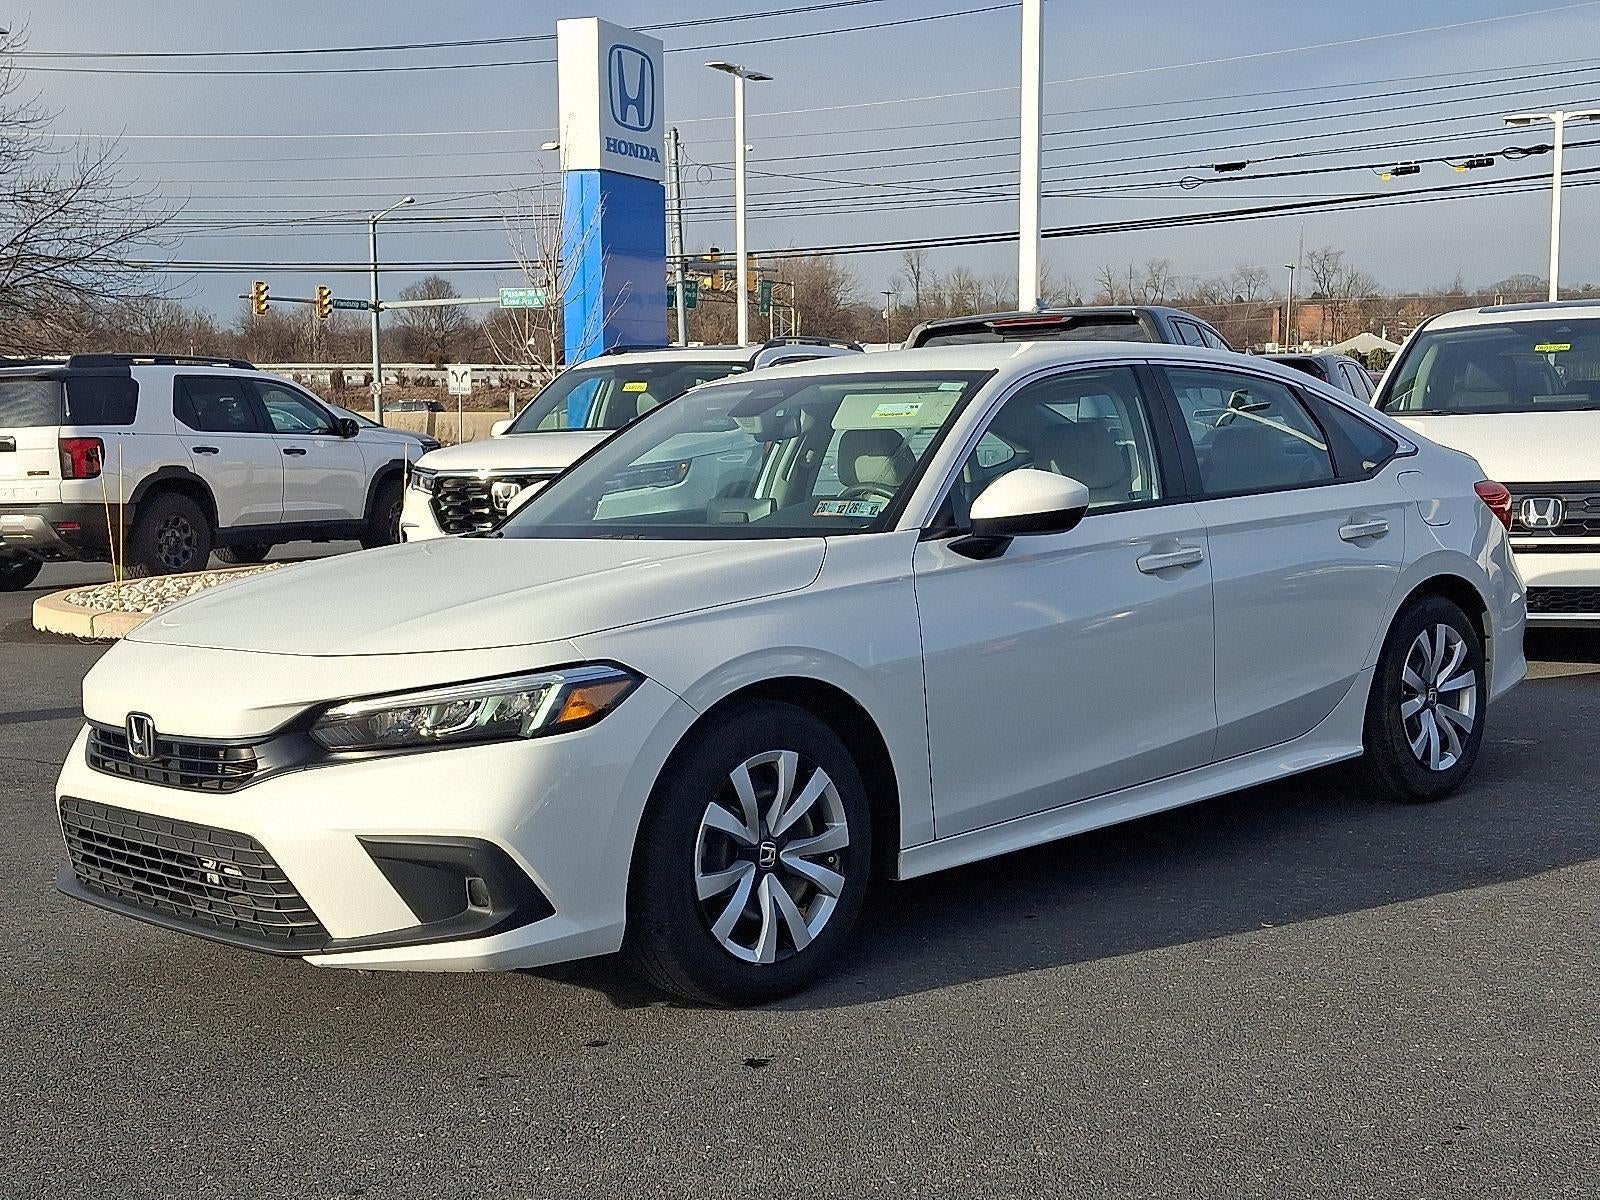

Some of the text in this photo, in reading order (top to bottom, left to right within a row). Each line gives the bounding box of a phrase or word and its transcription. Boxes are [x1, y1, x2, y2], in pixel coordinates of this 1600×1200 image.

[605, 137, 660, 163] HONDA
[333, 300, 359, 308] Friendship
[836, 504, 847, 513] 12
[849, 502, 879, 515] 26 12
